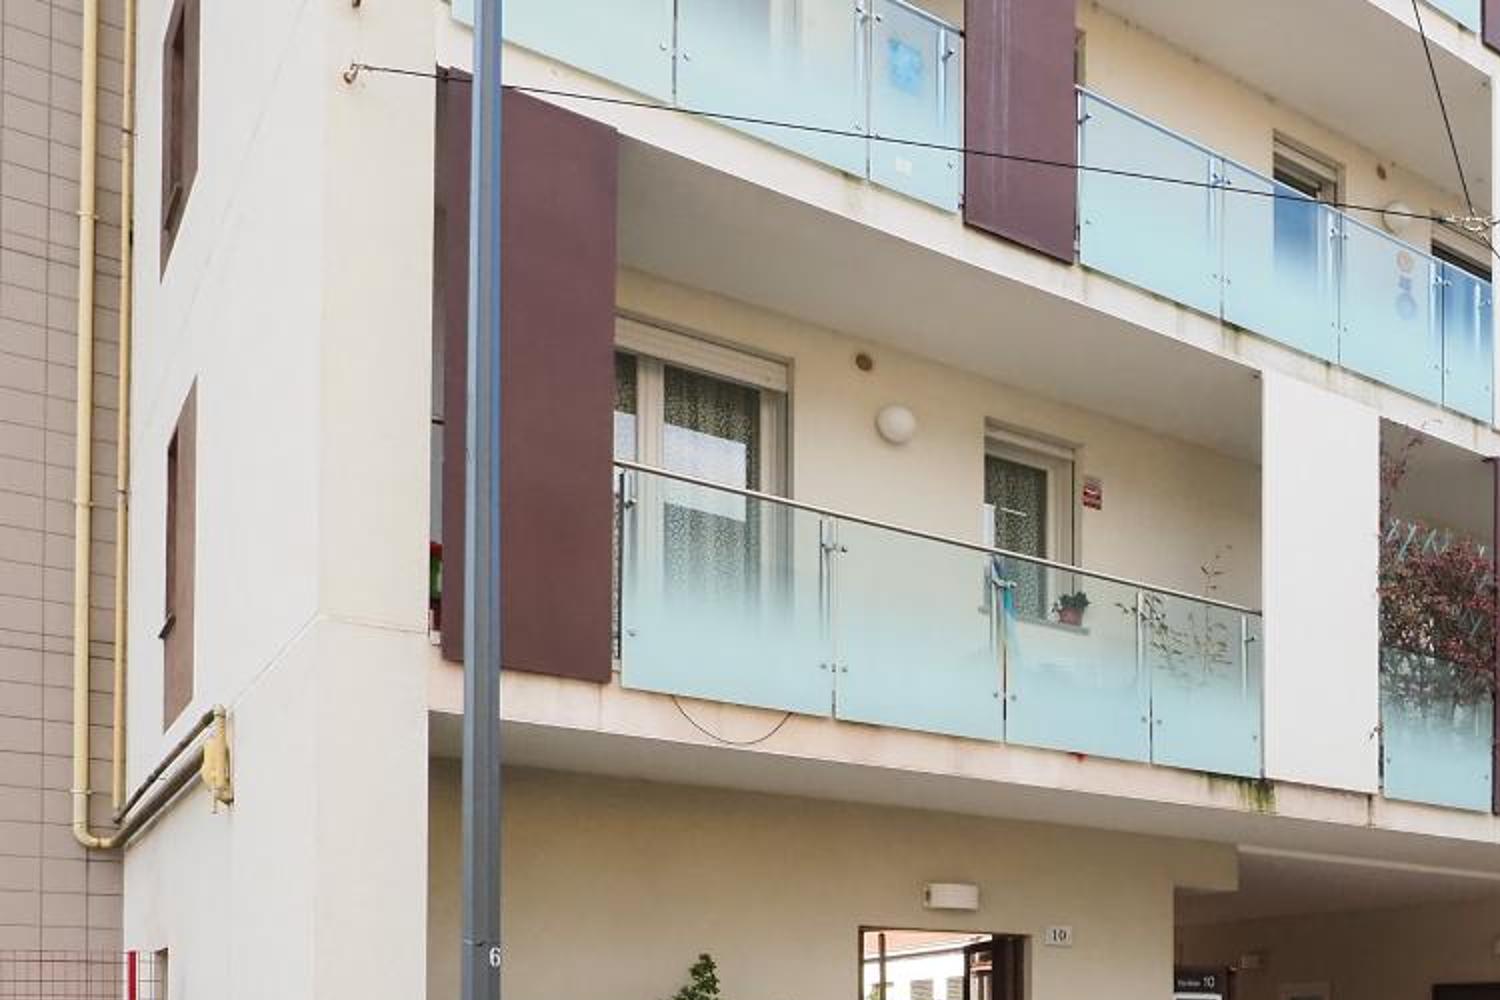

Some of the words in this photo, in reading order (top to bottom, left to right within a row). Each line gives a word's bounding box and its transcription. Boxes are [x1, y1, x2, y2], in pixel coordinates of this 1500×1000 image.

[1053, 929, 1067, 942] 10
[489, 947, 501, 967] 6
[1203, 975, 1215, 988] 10
